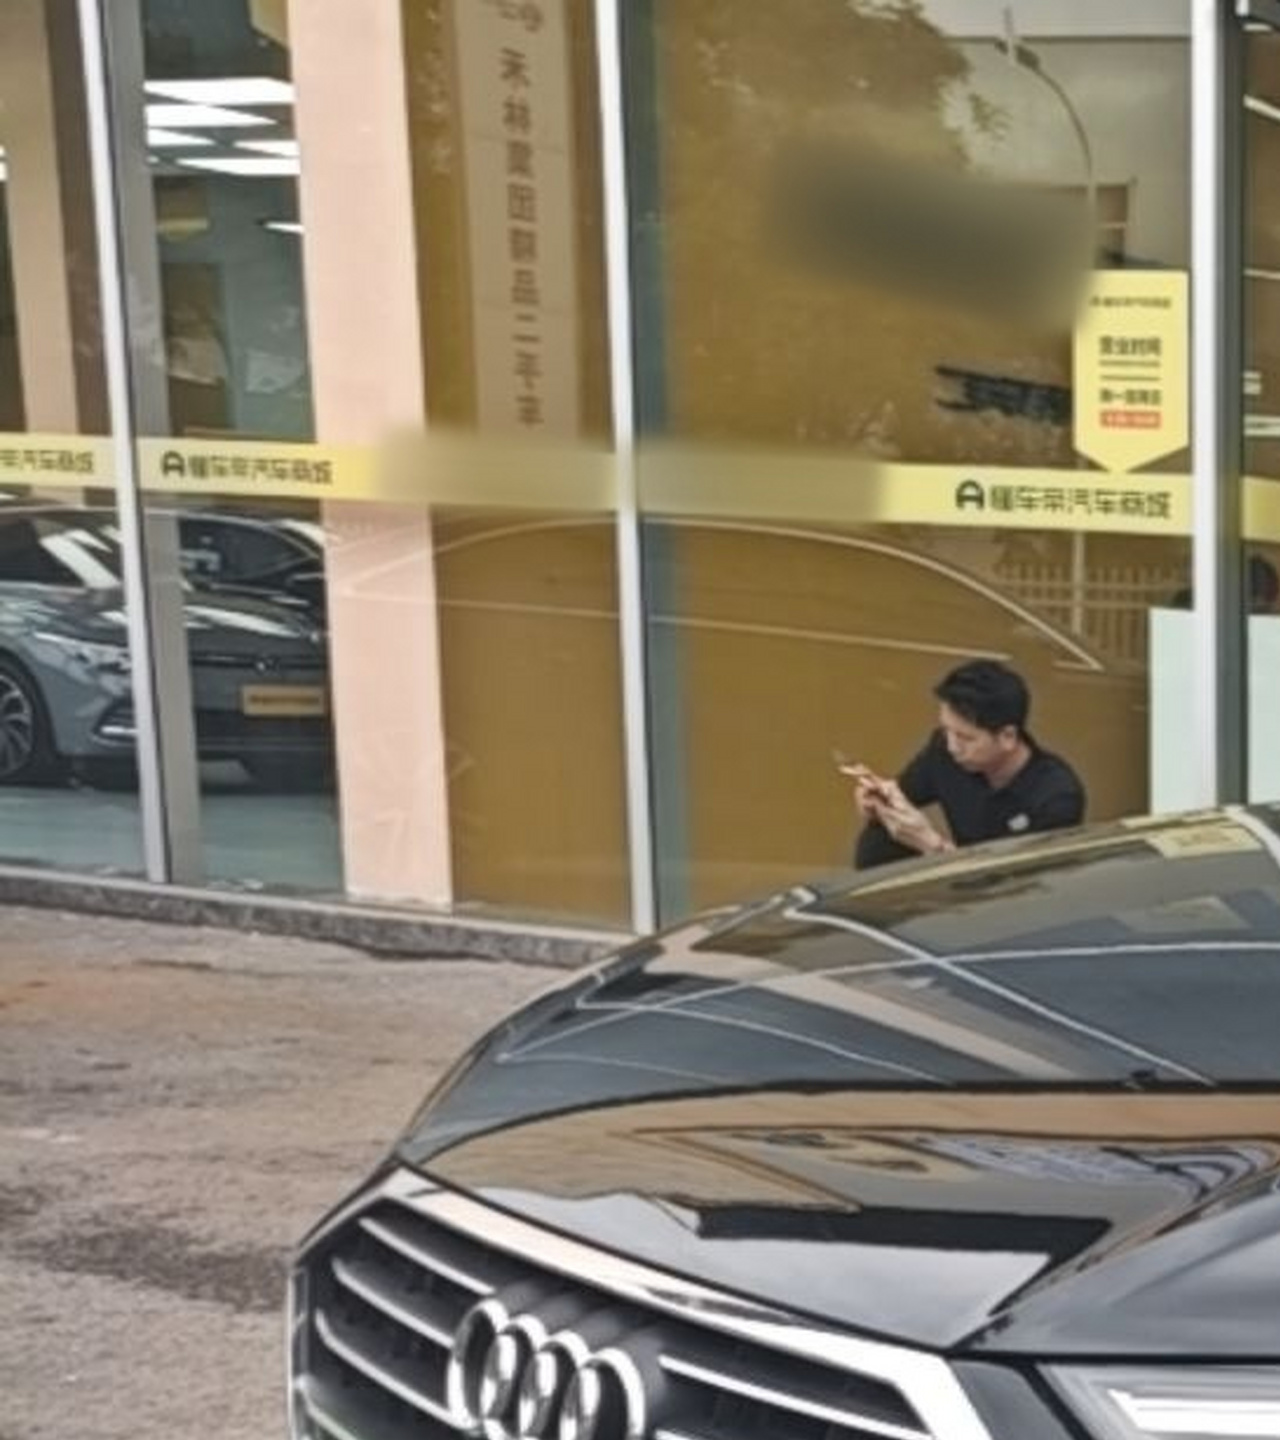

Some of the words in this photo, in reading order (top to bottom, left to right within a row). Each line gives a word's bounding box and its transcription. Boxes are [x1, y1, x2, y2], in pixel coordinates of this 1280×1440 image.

[991, 485, 1170, 519] 懂车帝汽车商城
